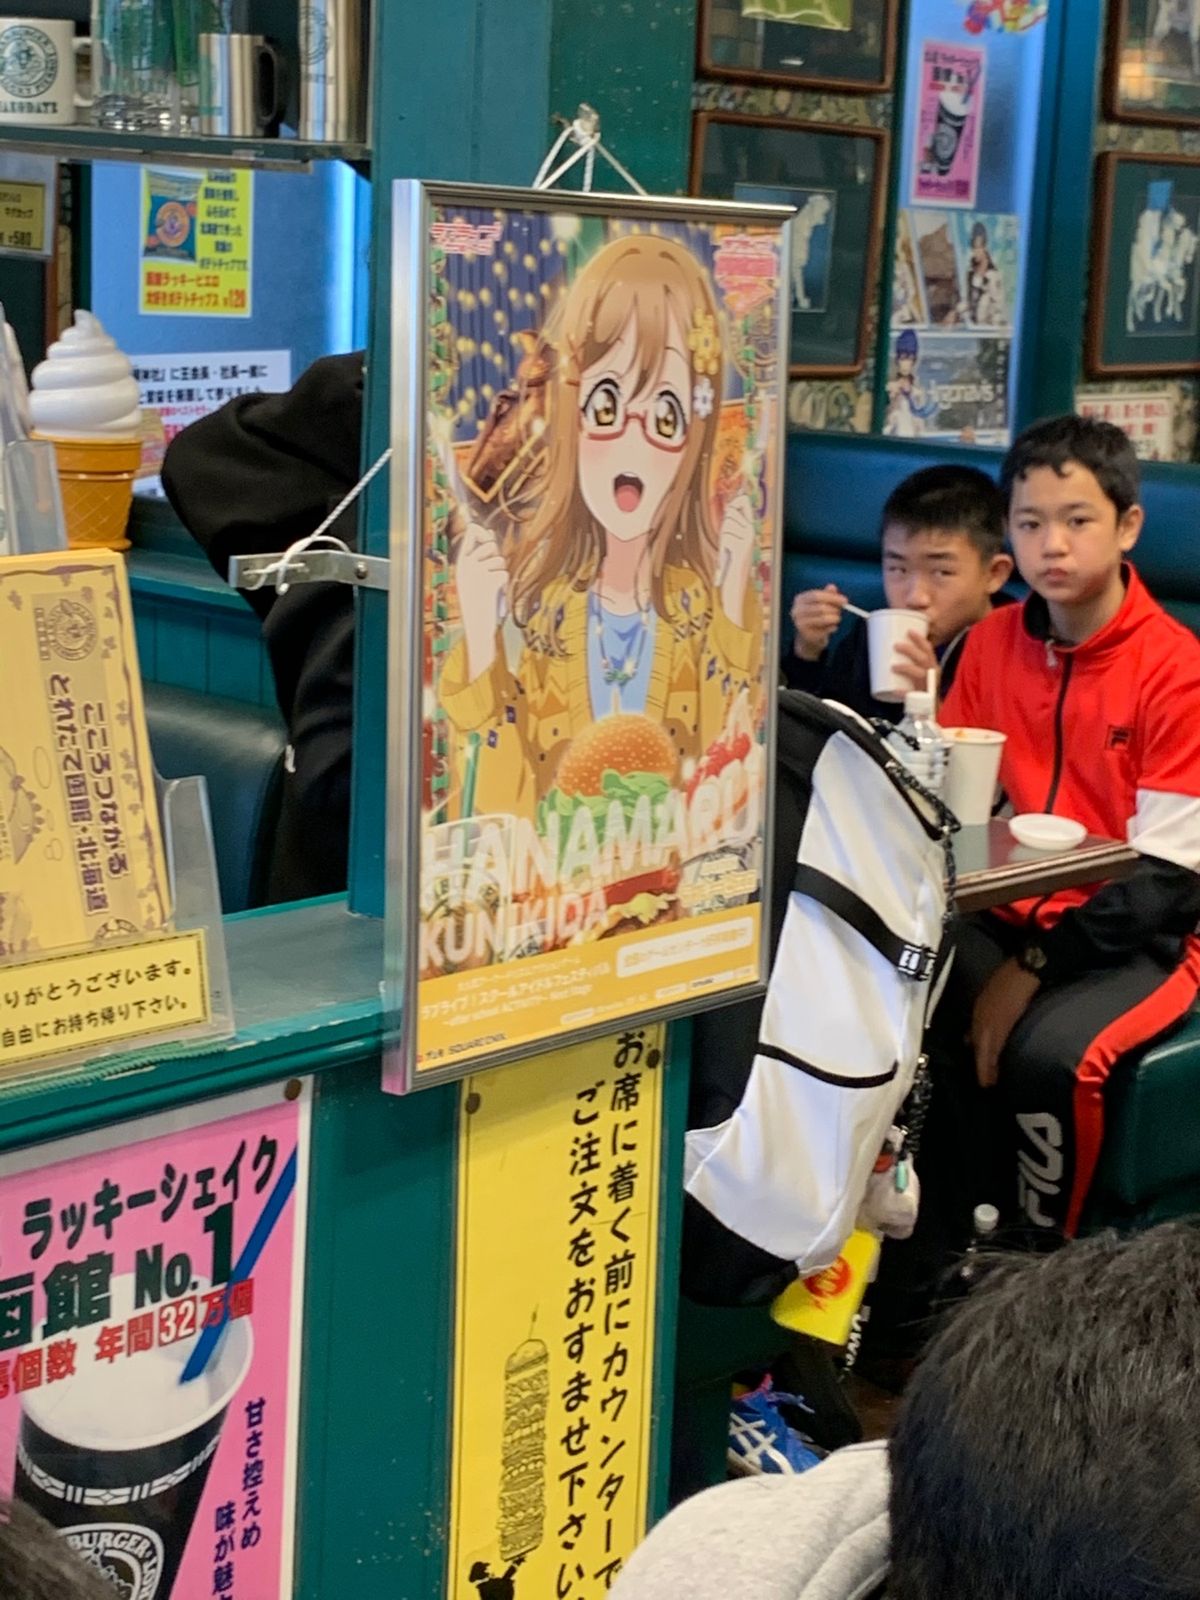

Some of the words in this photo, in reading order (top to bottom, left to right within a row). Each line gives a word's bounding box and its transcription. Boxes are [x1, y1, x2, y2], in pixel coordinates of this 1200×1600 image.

[0, 101, 58, 114] AKODATE
[83, 702, 128, 877] こころつながる
[421, 752, 764, 910] HANAMARU
[0, 959, 191, 1009] りがとうございます。
[419, 888, 610, 972] KUNIKIDA
[2, 994, 187, 1048] 自由にお持ち帰り下さい。
[22, 1134, 278, 1260] ラッキーシェイク
[1015, 1112, 1064, 1227] FILA
[556, 1080, 606, 1600] ご注文をおすませ下さい
[593, 1030, 646, 1590] お席に着く前にカウンターで
[241, 1397, 265, 1550] 甘さ控えめ
